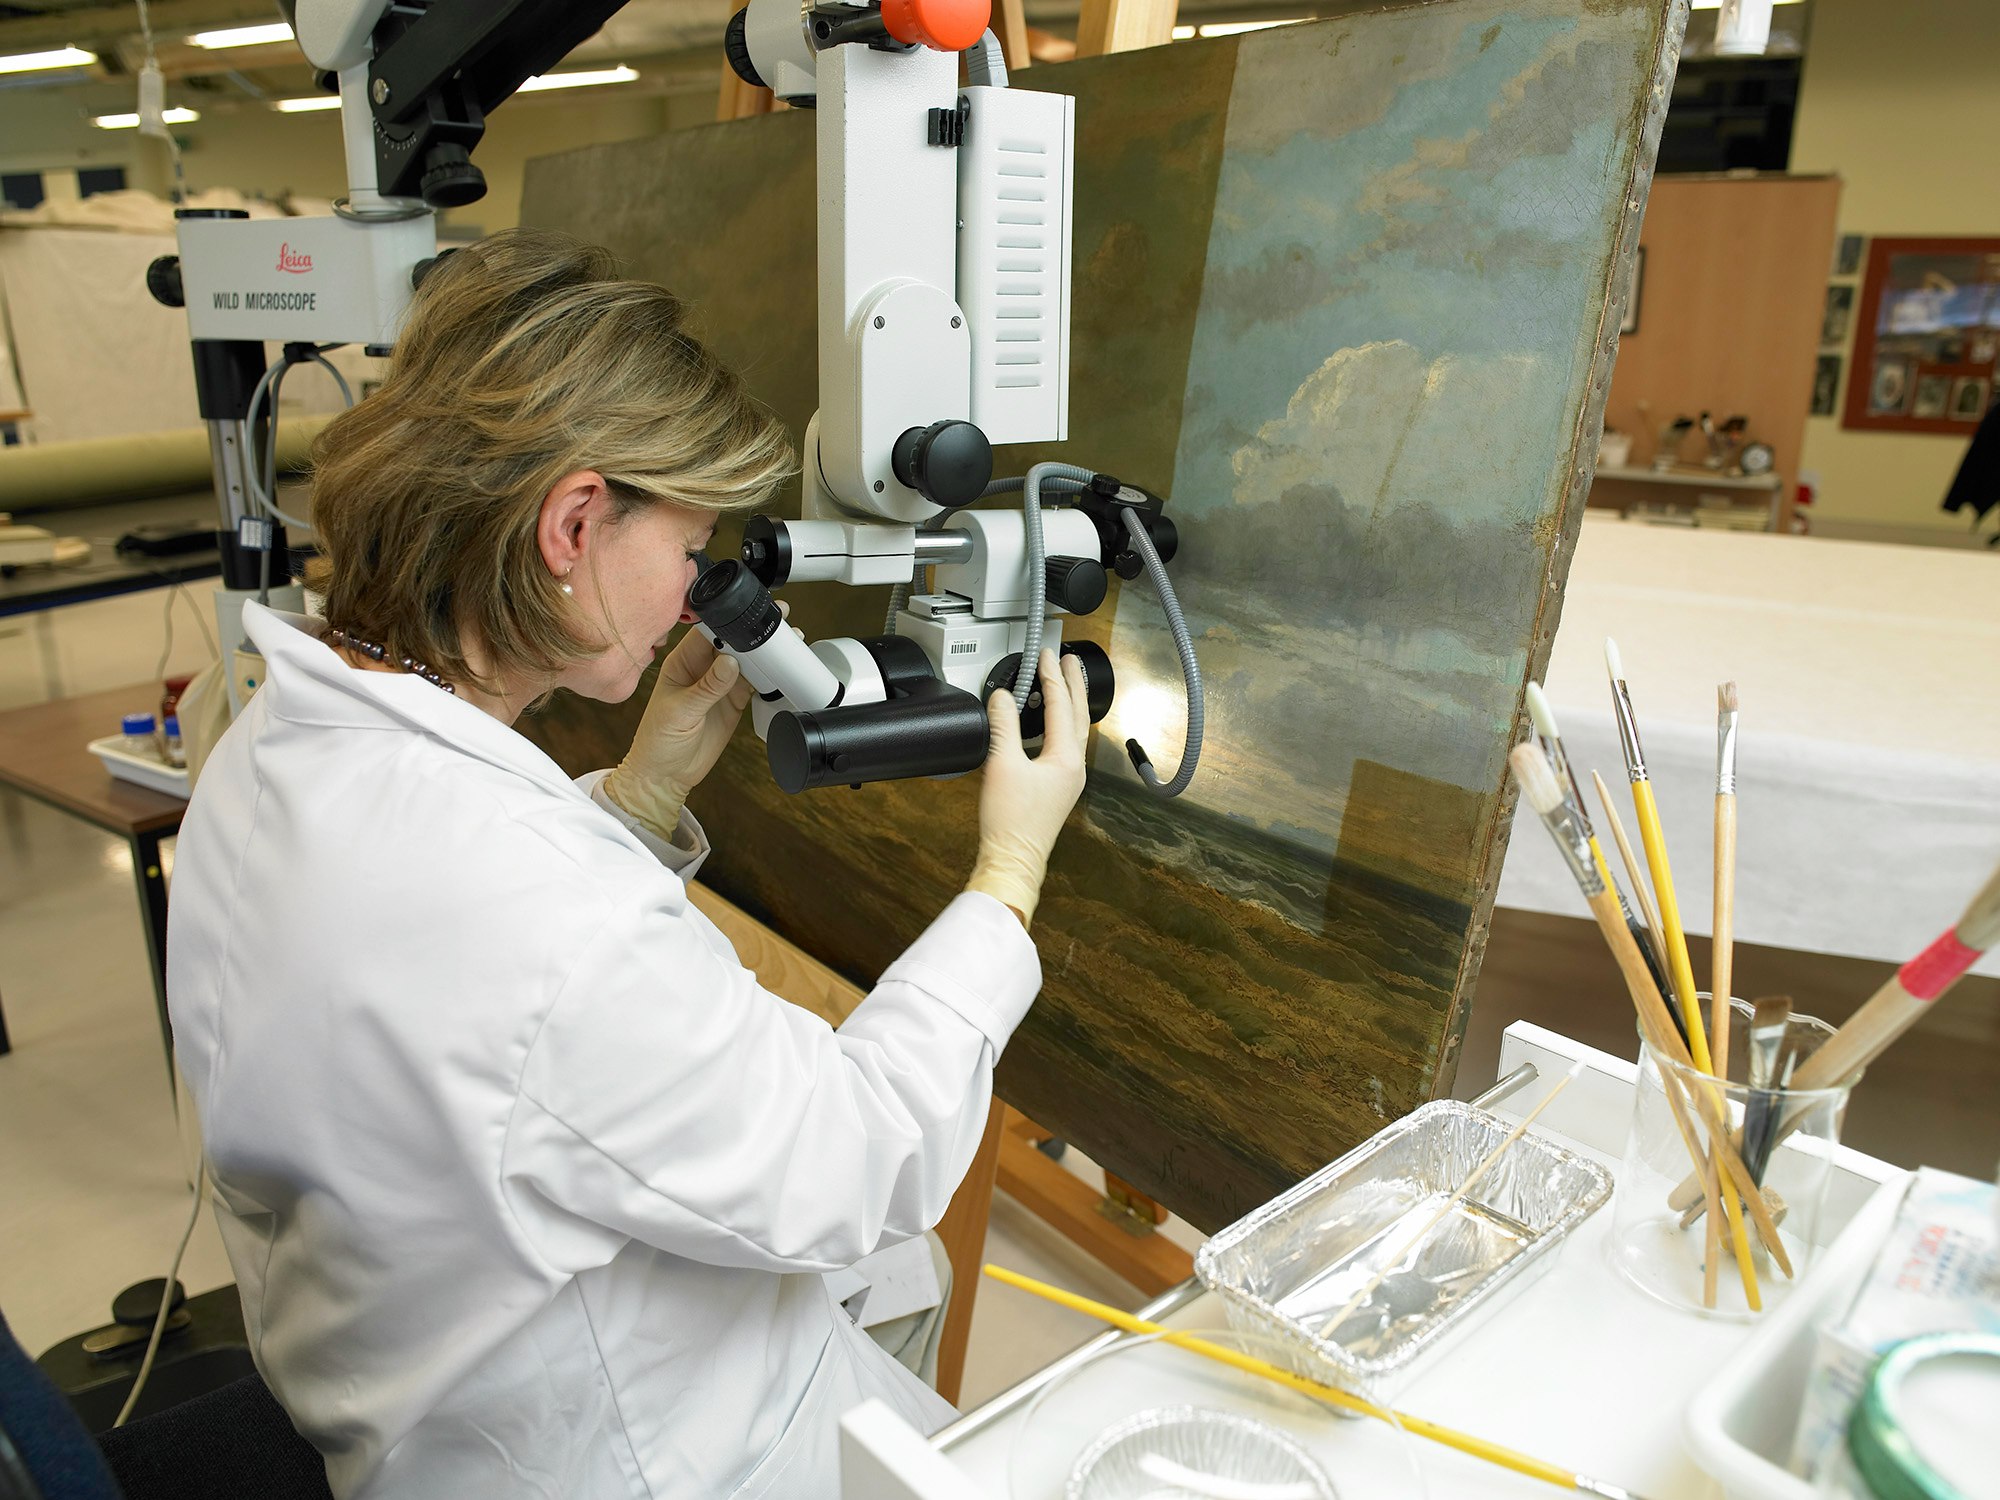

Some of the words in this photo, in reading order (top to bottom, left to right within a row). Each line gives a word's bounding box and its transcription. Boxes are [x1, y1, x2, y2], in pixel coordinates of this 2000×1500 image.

[275, 241, 314, 274] Leica
[213, 292, 240, 310] WILD
[245, 292, 317, 311] MICROSCOPE
